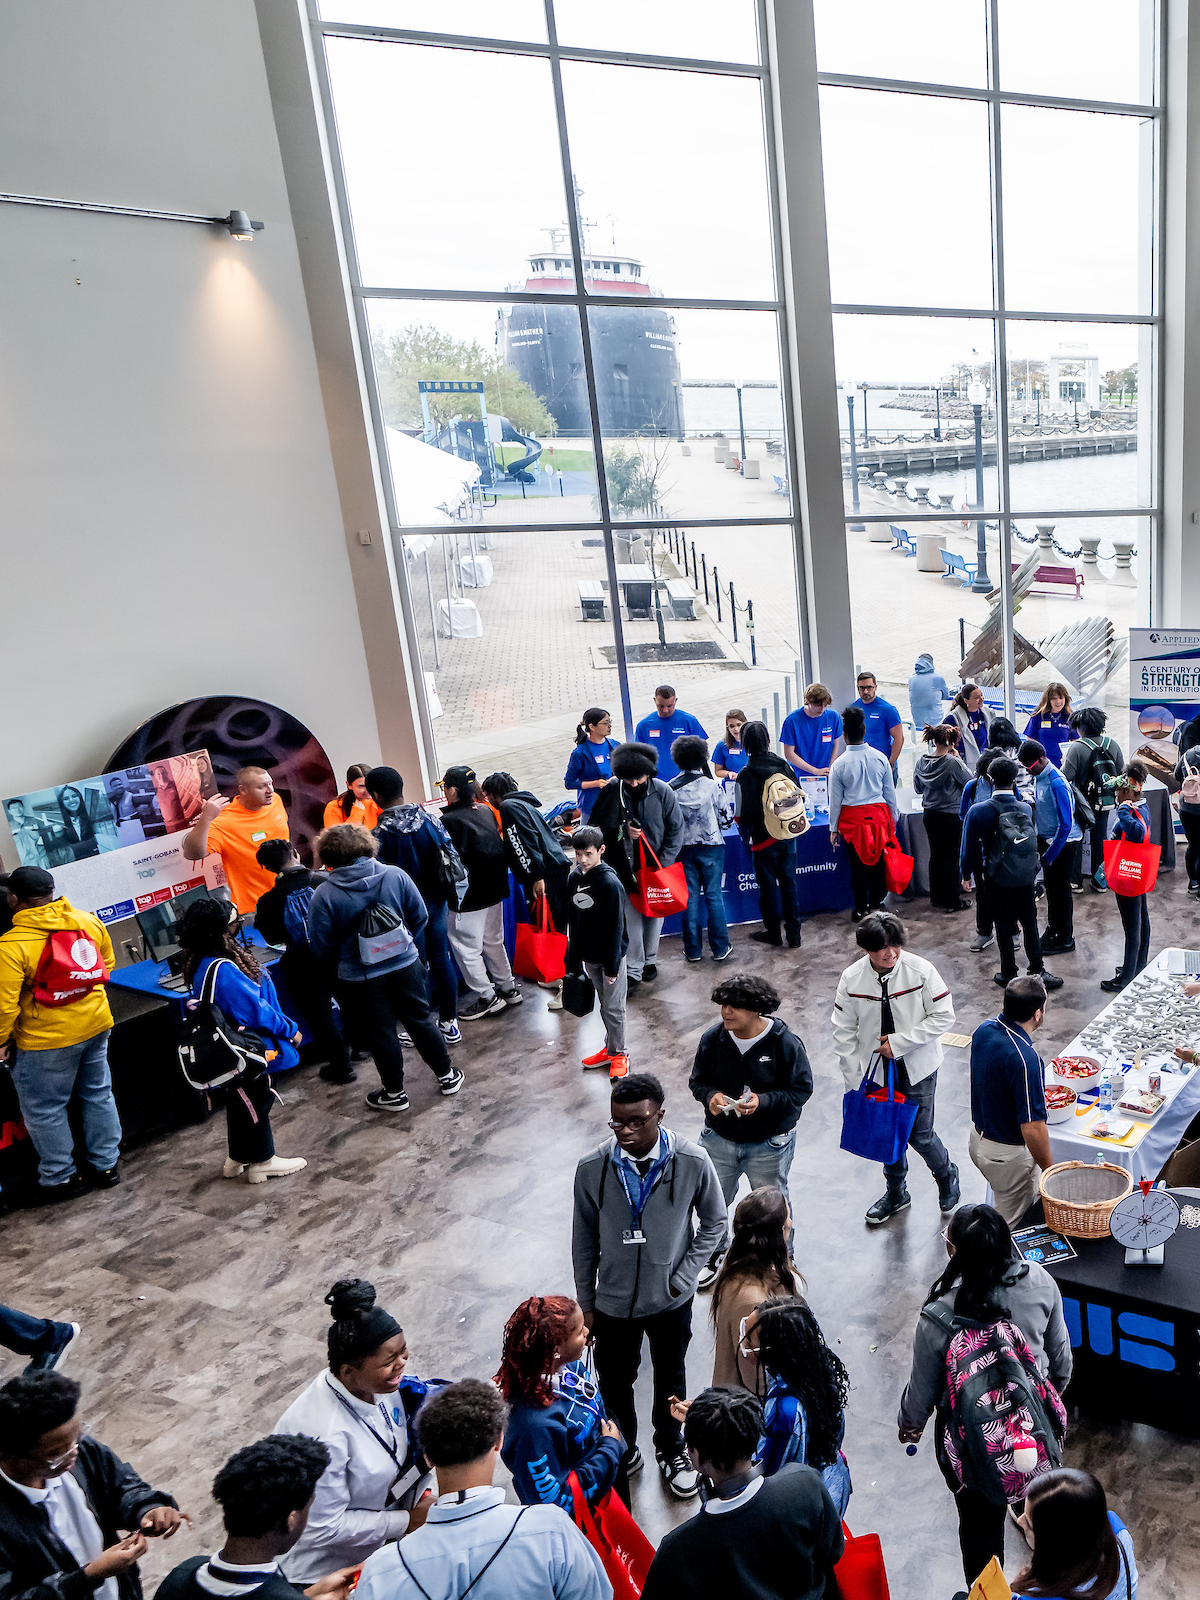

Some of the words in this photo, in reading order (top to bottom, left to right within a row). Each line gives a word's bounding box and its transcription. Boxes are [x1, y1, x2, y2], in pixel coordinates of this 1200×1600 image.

[1161, 635, 1200, 644] APPLIED
[1141, 665, 1148, 673] A
[1149, 665, 1191, 674] CENTURY
[506, 827, 523, 857] GOOD
[132, 847, 180, 866] SAINT-GOBAIN
[795, 861, 838, 875] mmunity
[1120, 858, 1143, 868] SHERWIN
[646, 886, 671, 894] SHERWIN
